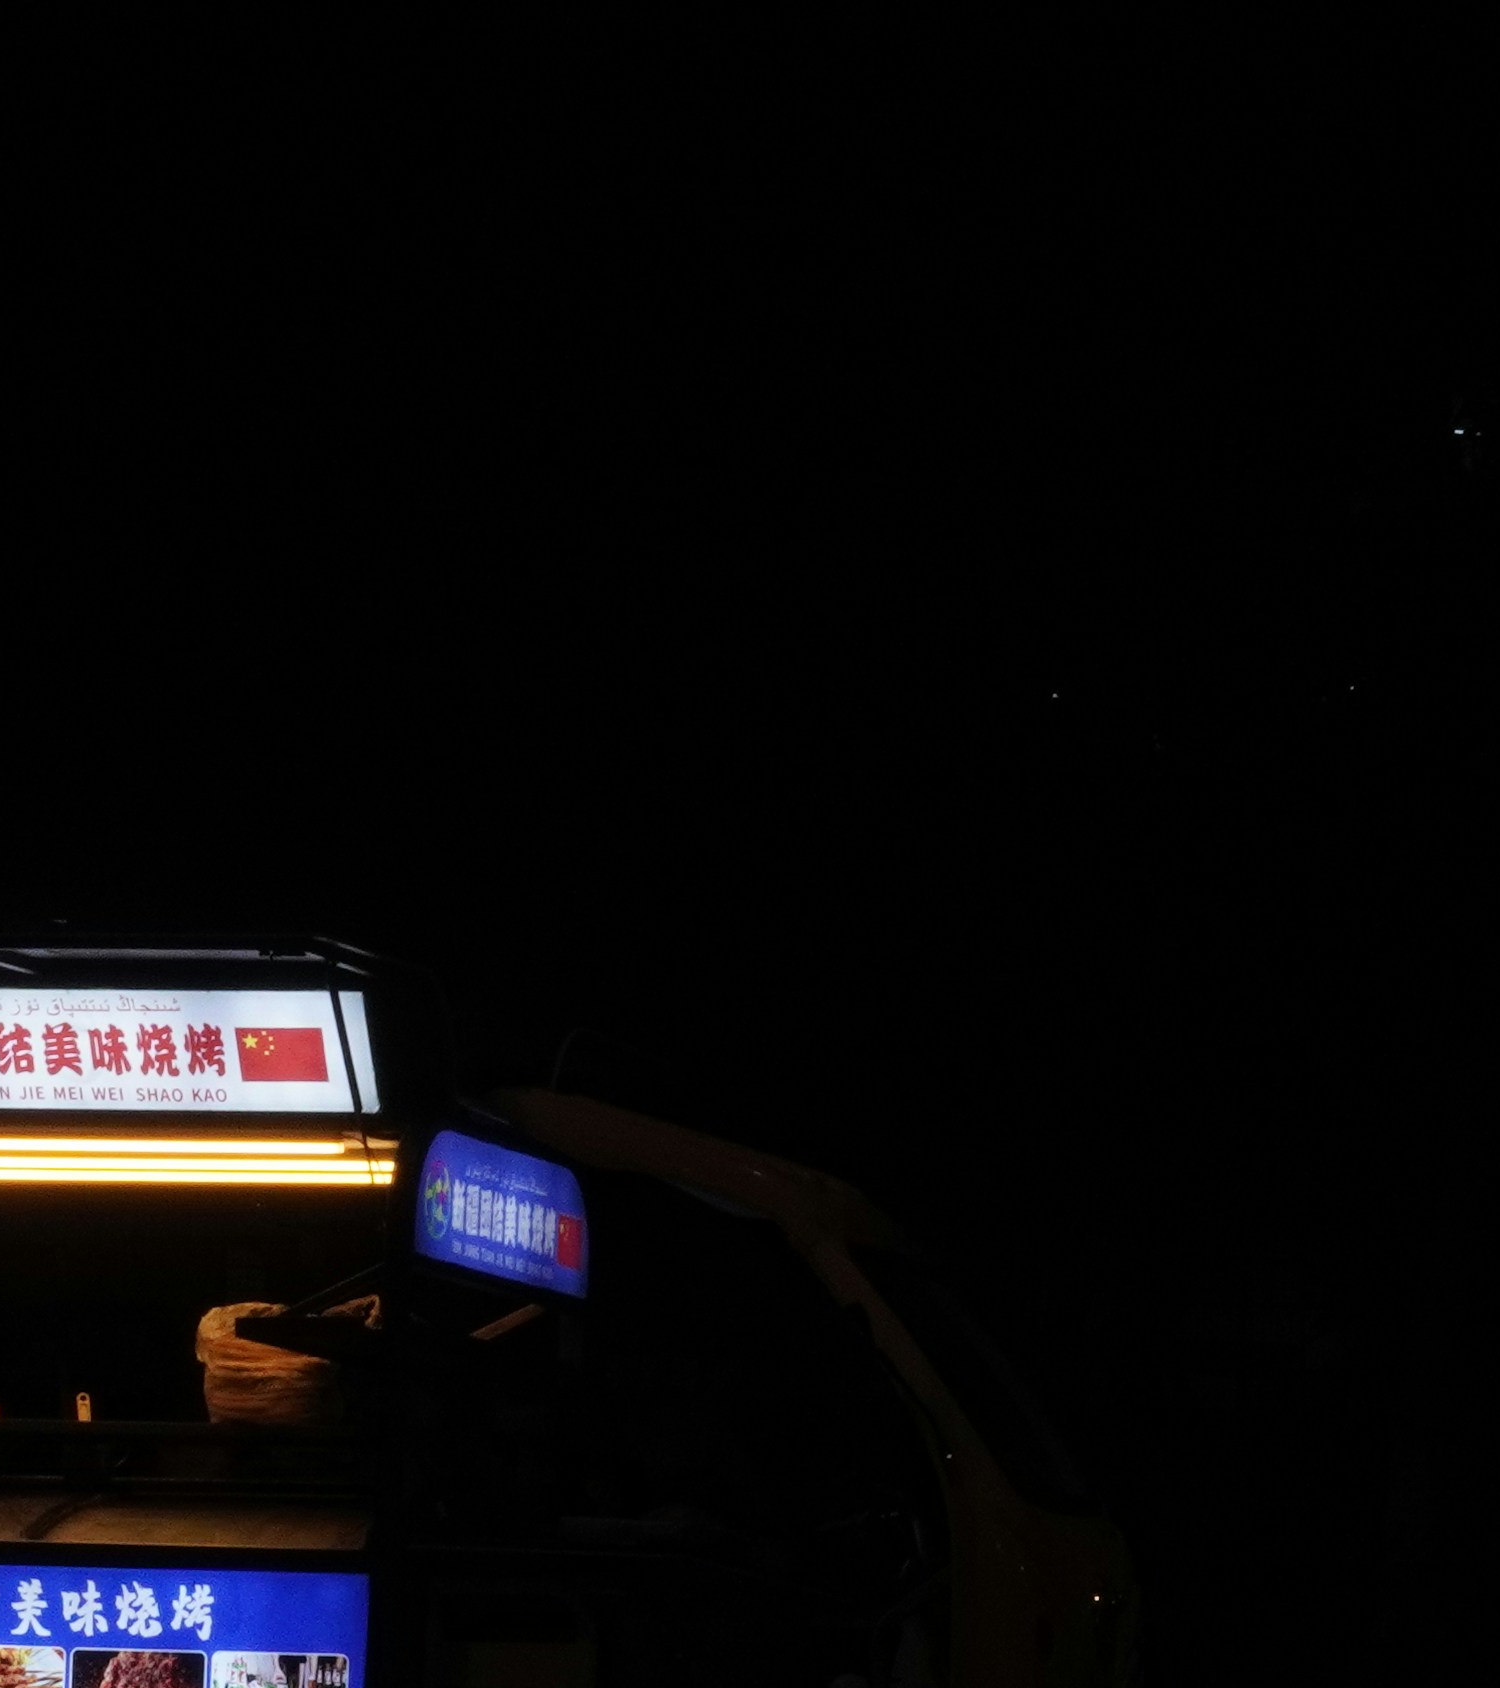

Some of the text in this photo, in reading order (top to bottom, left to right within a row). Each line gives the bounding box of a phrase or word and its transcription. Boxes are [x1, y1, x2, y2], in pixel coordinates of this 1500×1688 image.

[18, 1085, 46, 1101] JIE
[53, 1086, 84, 1101] MEI
[90, 1086, 125, 1102] WEI
[135, 1087, 184, 1103] SHAO
[191, 1088, 228, 1103] KAO
